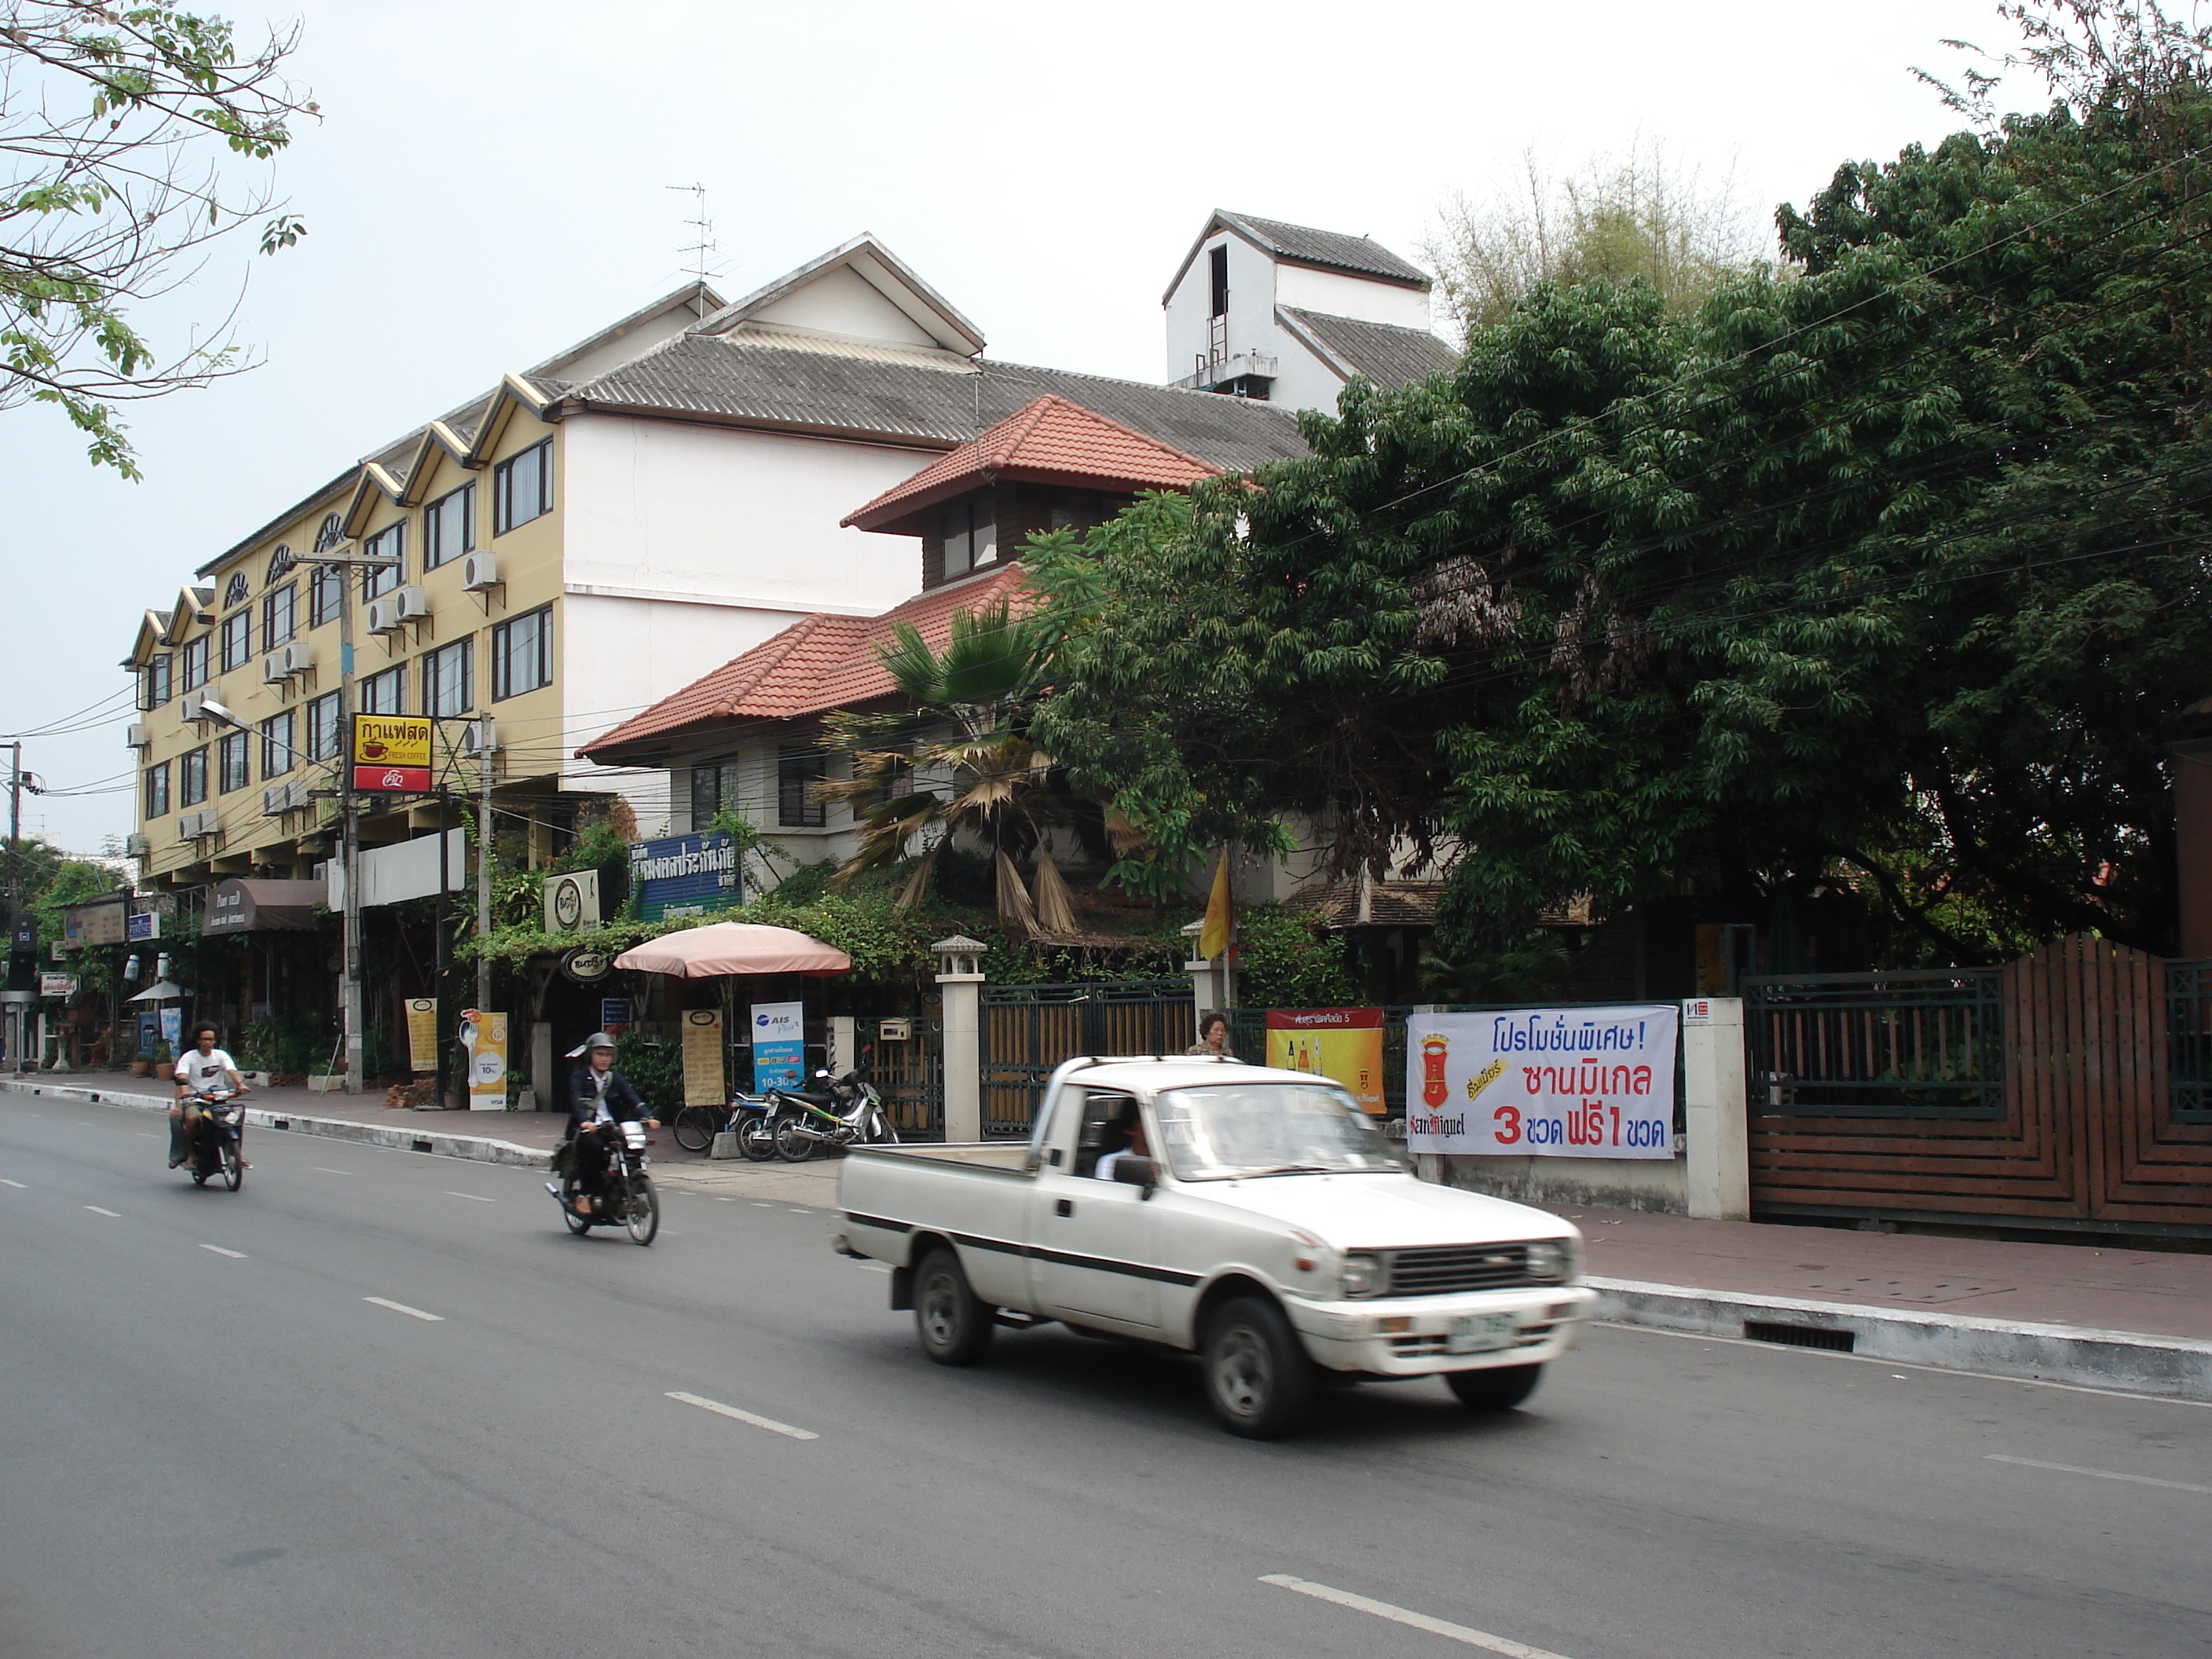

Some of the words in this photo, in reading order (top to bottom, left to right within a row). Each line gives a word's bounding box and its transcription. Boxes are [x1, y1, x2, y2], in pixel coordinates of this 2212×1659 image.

[362, 721, 428, 741] กาแฟสด
[771, 1016, 789, 1024] AIS
[1344, 1014, 1350, 1023] 5
[1492, 1015, 1646, 1052] โปรโมชั่นพิเศษ!
[1522, 1058, 1653, 1095] ซานมิเกล
[1493, 1105, 1522, 1144] 3
[1527, 1118, 1563, 1144] ขวด
[1568, 1098, 1604, 1145] ฟรี
[1610, 1106, 1621, 1147] 1
[1627, 1119, 1664, 1148] ขวด
